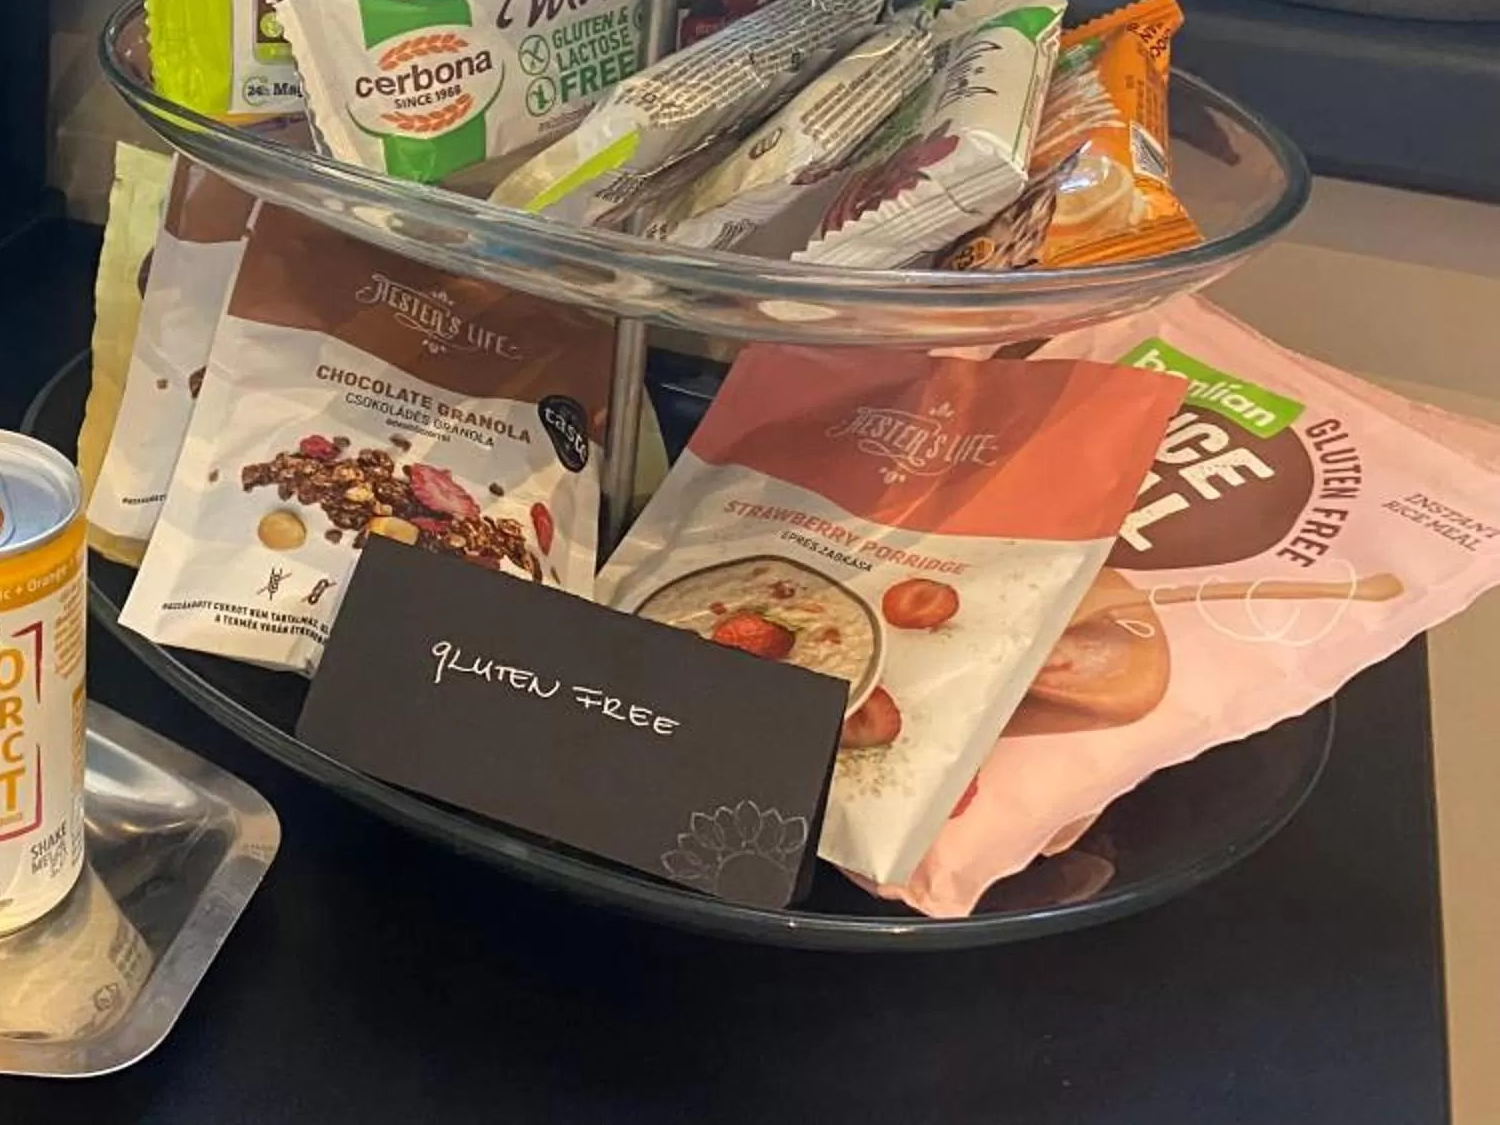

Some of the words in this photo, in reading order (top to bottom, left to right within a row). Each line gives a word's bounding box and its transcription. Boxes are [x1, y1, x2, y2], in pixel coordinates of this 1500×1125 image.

[552, 10, 615, 50] GLUTEN
[556, 26, 633, 72] LACTOSE
[355, 50, 493, 99] cerbona
[560, 49, 638, 104] FREE
[394, 93, 433, 110] SINCE
[316, 364, 433, 410] CHOCOLATE
[437, 401, 532, 445] GRANOLA
[433, 417, 495, 448] GRANOLA
[1155, 411, 1276, 501] ICE
[1305, 418, 1362, 499] GLUTEN
[724, 500, 860, 547] STRAWBERRY
[859, 540, 972, 575] PORRIDGE
[1275, 507, 1349, 568] FREE
[572, 685, 681, 735] FREE
[30, 820, 68, 856] SHAKE
